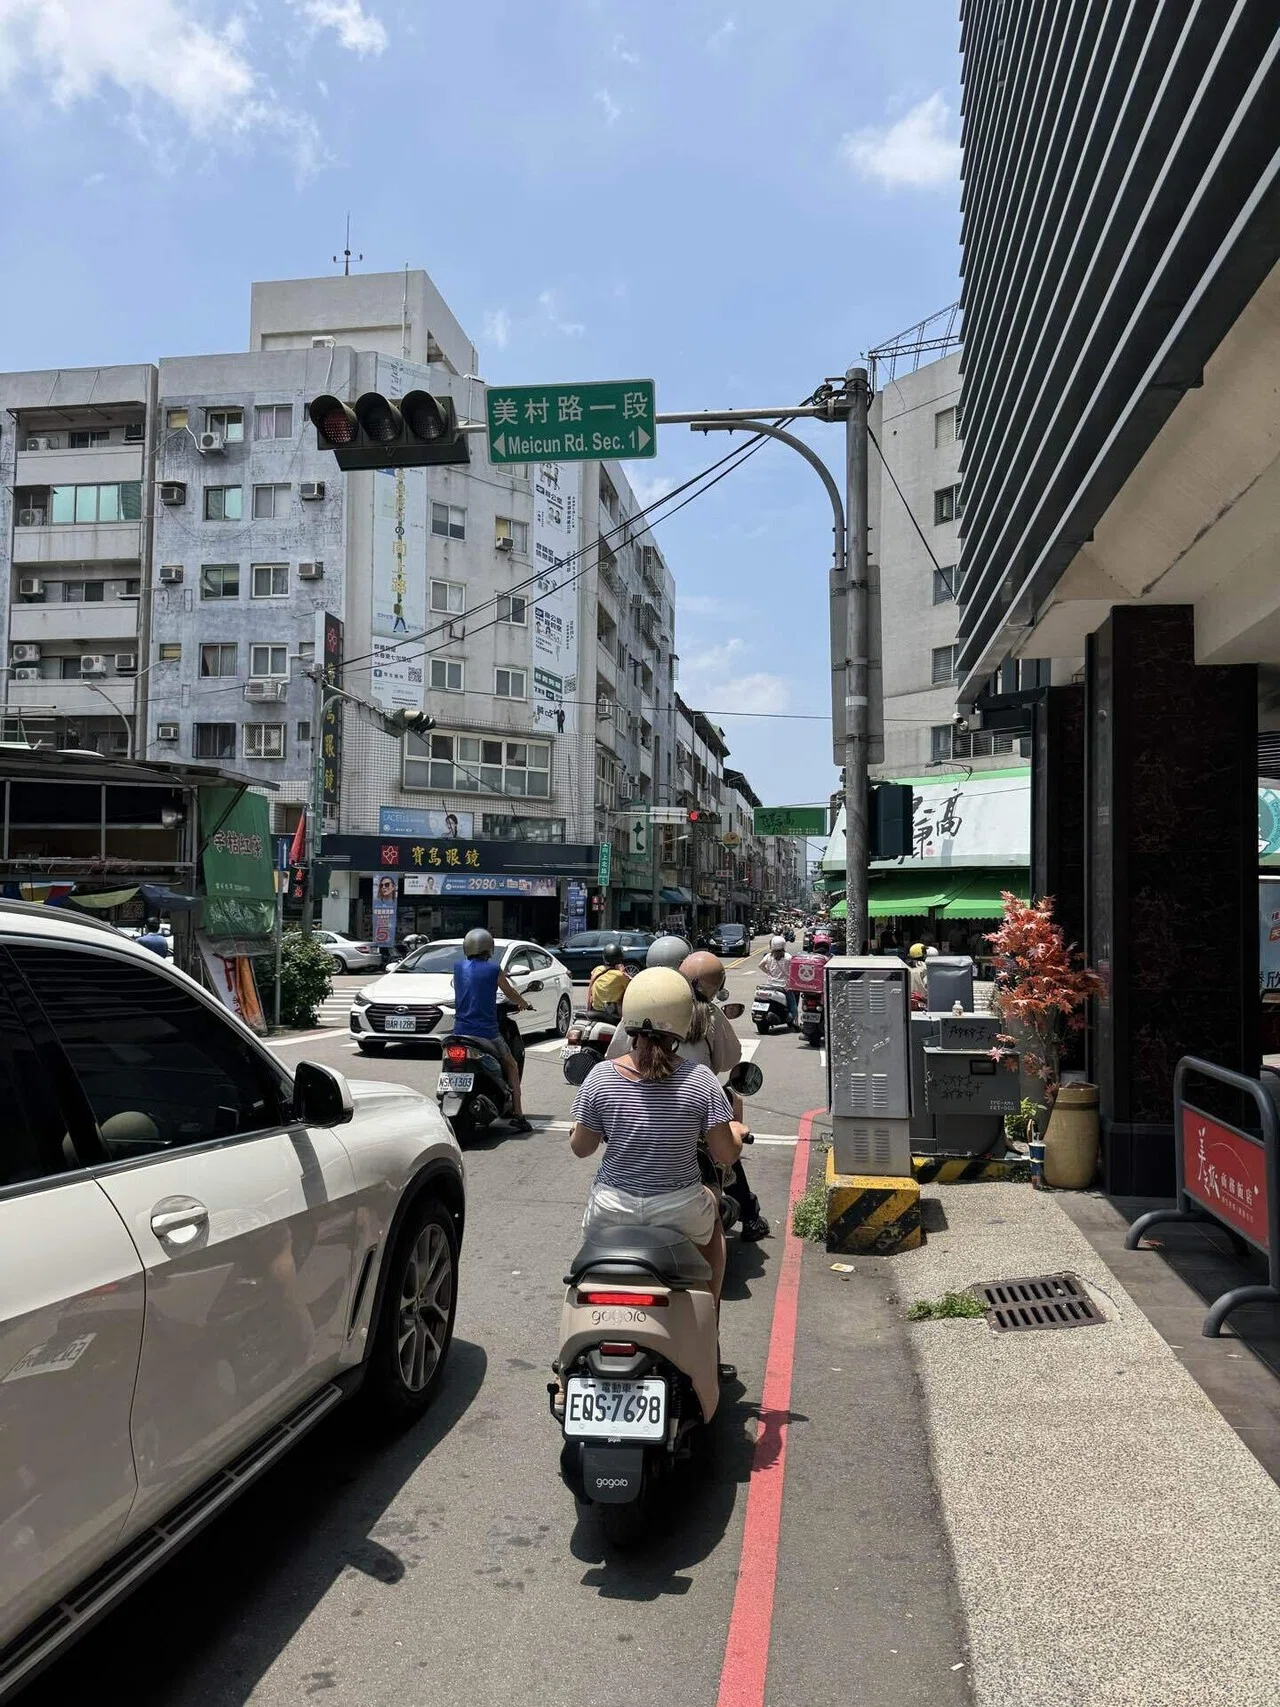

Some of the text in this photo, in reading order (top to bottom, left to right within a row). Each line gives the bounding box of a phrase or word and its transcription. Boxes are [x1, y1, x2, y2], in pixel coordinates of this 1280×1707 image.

[493, 392, 648, 426] 美村路一段
[508, 430, 636, 455] Meicun Rd. Sec. 1
[411, 845, 481, 868] 寶島眼鏡
[467, 878, 497, 890] 2980
[602, 1381, 632, 1394] 電動車
